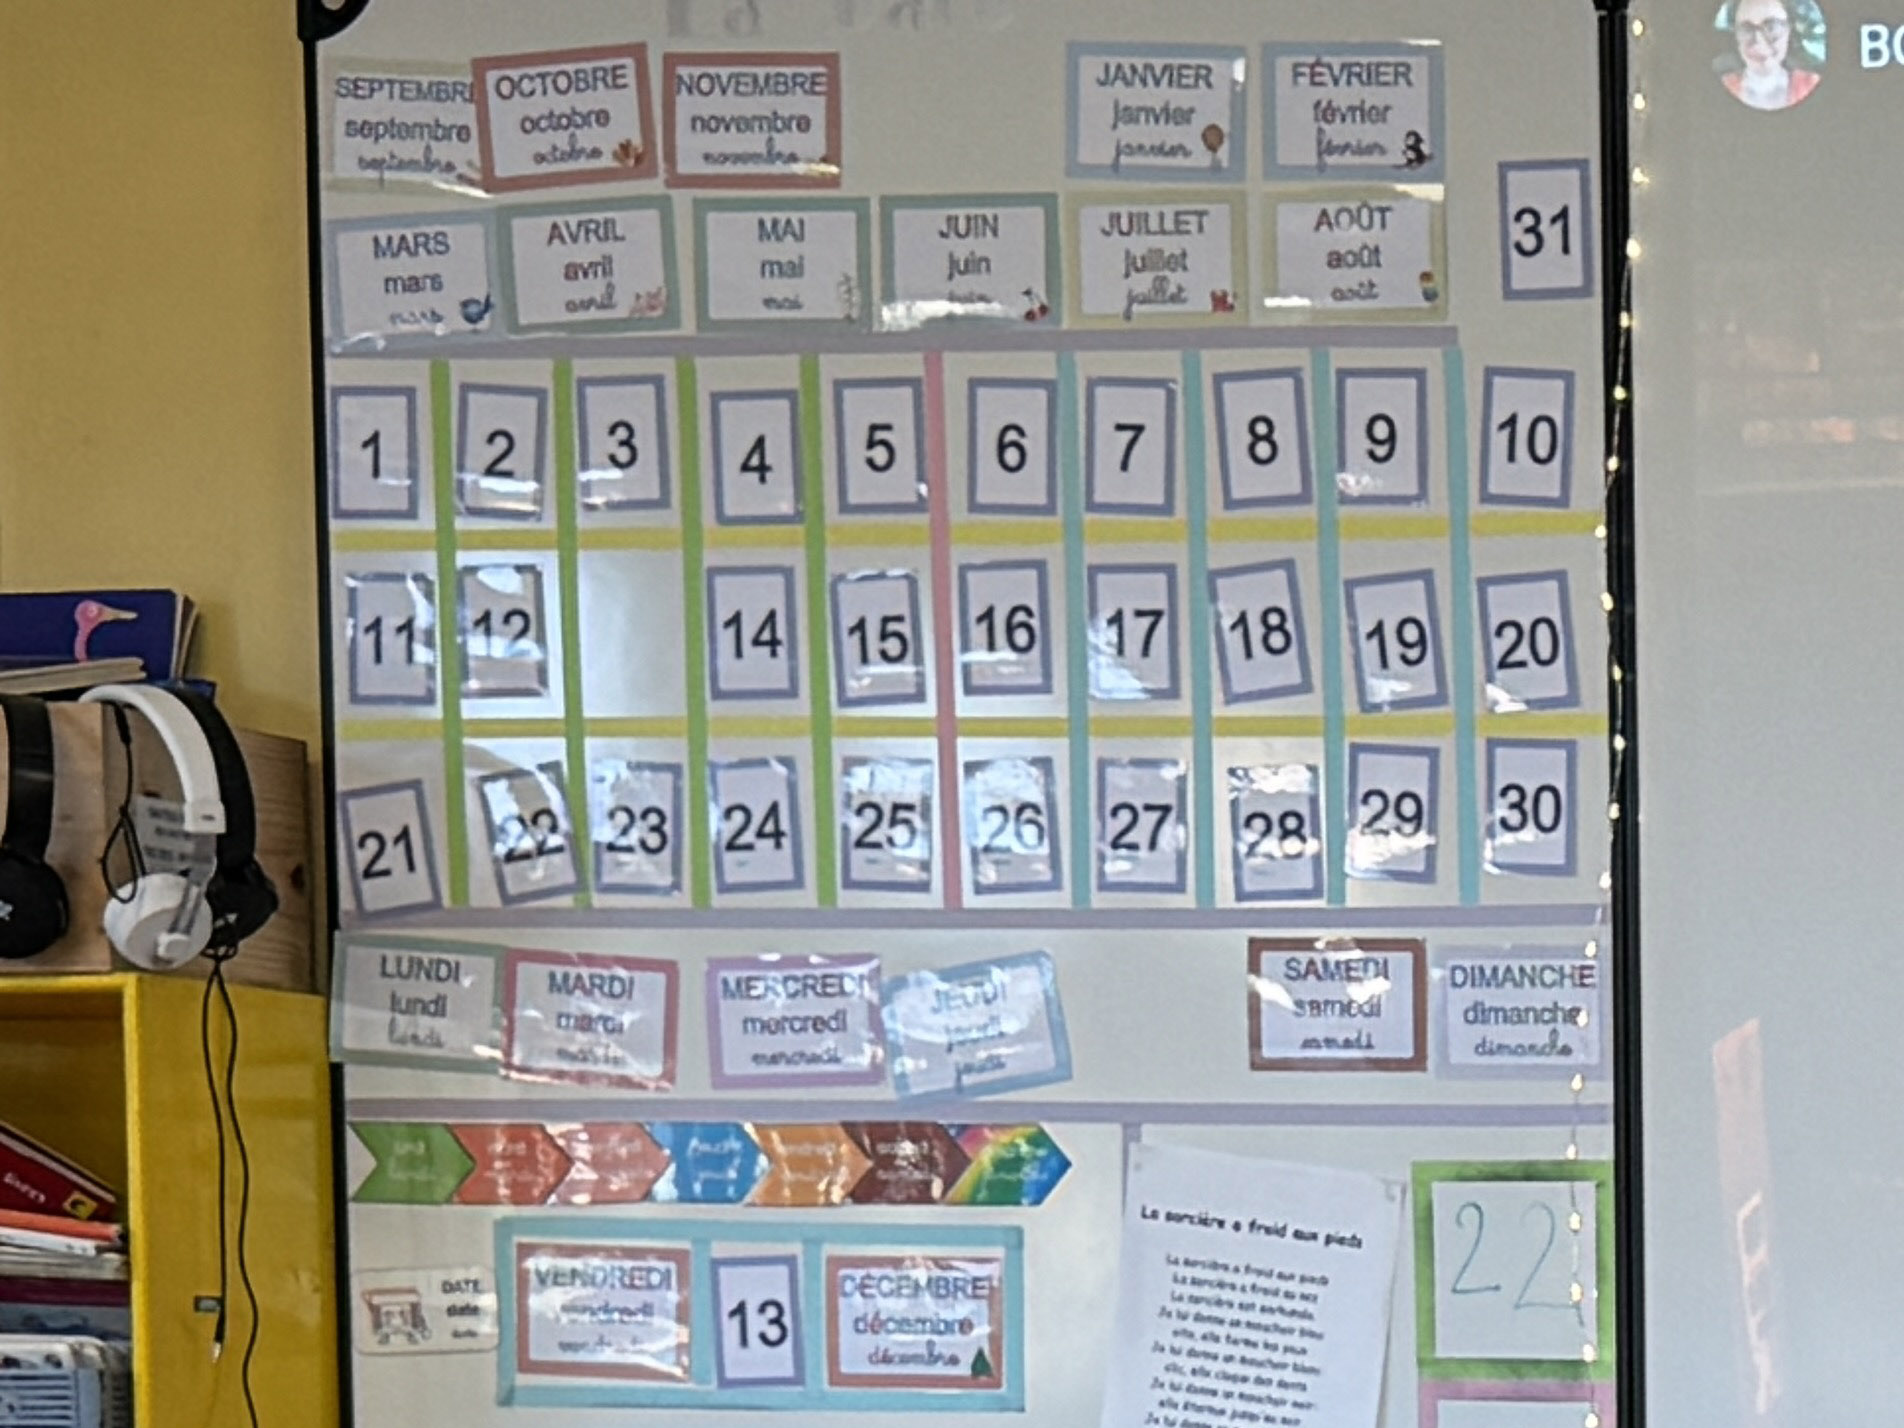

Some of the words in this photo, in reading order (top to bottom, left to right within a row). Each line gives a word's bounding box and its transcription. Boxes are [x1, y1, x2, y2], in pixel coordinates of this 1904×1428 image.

[496, 65, 629, 99] OCTOBRE
[677, 71, 827, 97] NOVEMBRE
[1096, 62, 1214, 90] JANVIER
[1292, 57, 1413, 88] FÉVRIER
[520, 107, 611, 134] octobre
[690, 110, 811, 135] novembre
[1112, 99, 1196, 131] janvier
[1313, 98, 1393, 125] février
[345, 116, 471, 144] septembre
[548, 217, 626, 246] AVRIL
[758, 216, 805, 243] MAI
[939, 213, 999, 240] JUIN
[1100, 209, 1210, 237] JUILLET
[1313, 201, 1393, 232] AOÛT
[1513, 206, 1573, 258] 31
[373, 231, 450, 259] MARS
[1327, 242, 1383, 270] août
[563, 255, 614, 281] avril
[760, 254, 805, 280] mai
[947, 250, 992, 281] juin
[1124, 247, 1189, 279] juillet
[384, 271, 443, 294] mars
[361, 430, 383, 480] 1
[484, 429, 516, 478] 2
[606, 420, 638, 470] 3
[864, 423, 896, 472] 5
[996, 424, 1028, 472] 6
[1114, 423, 1145, 472] 7
[1248, 415, 1279, 465] 8
[1365, 413, 1397, 463] 9
[1497, 413, 1558, 464] 10
[740, 435, 773, 484] 4
[363, 616, 418, 665] 11
[473, 607, 532, 650] 12
[722, 609, 783, 660] 14
[847, 615, 909, 666] 15
[976, 604, 1037, 655] 16
[1107, 608, 1164, 659] 17
[1229, 606, 1293, 661] 18
[1365, 616, 1428, 670] 19
[1494, 617, 1560, 670] 20
[853, 803, 916, 850] 25
[981, 802, 1046, 851] 26
[1360, 789, 1424, 838] 29
[1499, 785, 1562, 834] 30
[504, 808, 564, 863] 22
[606, 806, 668, 855] 23
[724, 801, 786, 853] 24
[1109, 802, 1173, 852] 27
[1243, 809, 1306, 860] 28
[358, 827, 417, 880] 21
[379, 953, 460, 982] LUNDI
[1284, 956, 1389, 982] SAMEDI
[1450, 963, 1597, 989] DIMANCHE
[548, 970, 635, 1000] MARDI
[721, 974, 867, 1004] MERCREDI
[390, 991, 447, 1018] lundi
[742, 1008, 848, 1035] mercredi
[1463, 1000, 1586, 1025] dimanche
[1249, 1217, 1287, 1239] froid
[441, 1278, 481, 1296] DATE
[840, 1270, 990, 1299] DÉCEMBRE
[726, 1299, 788, 1349] 13
